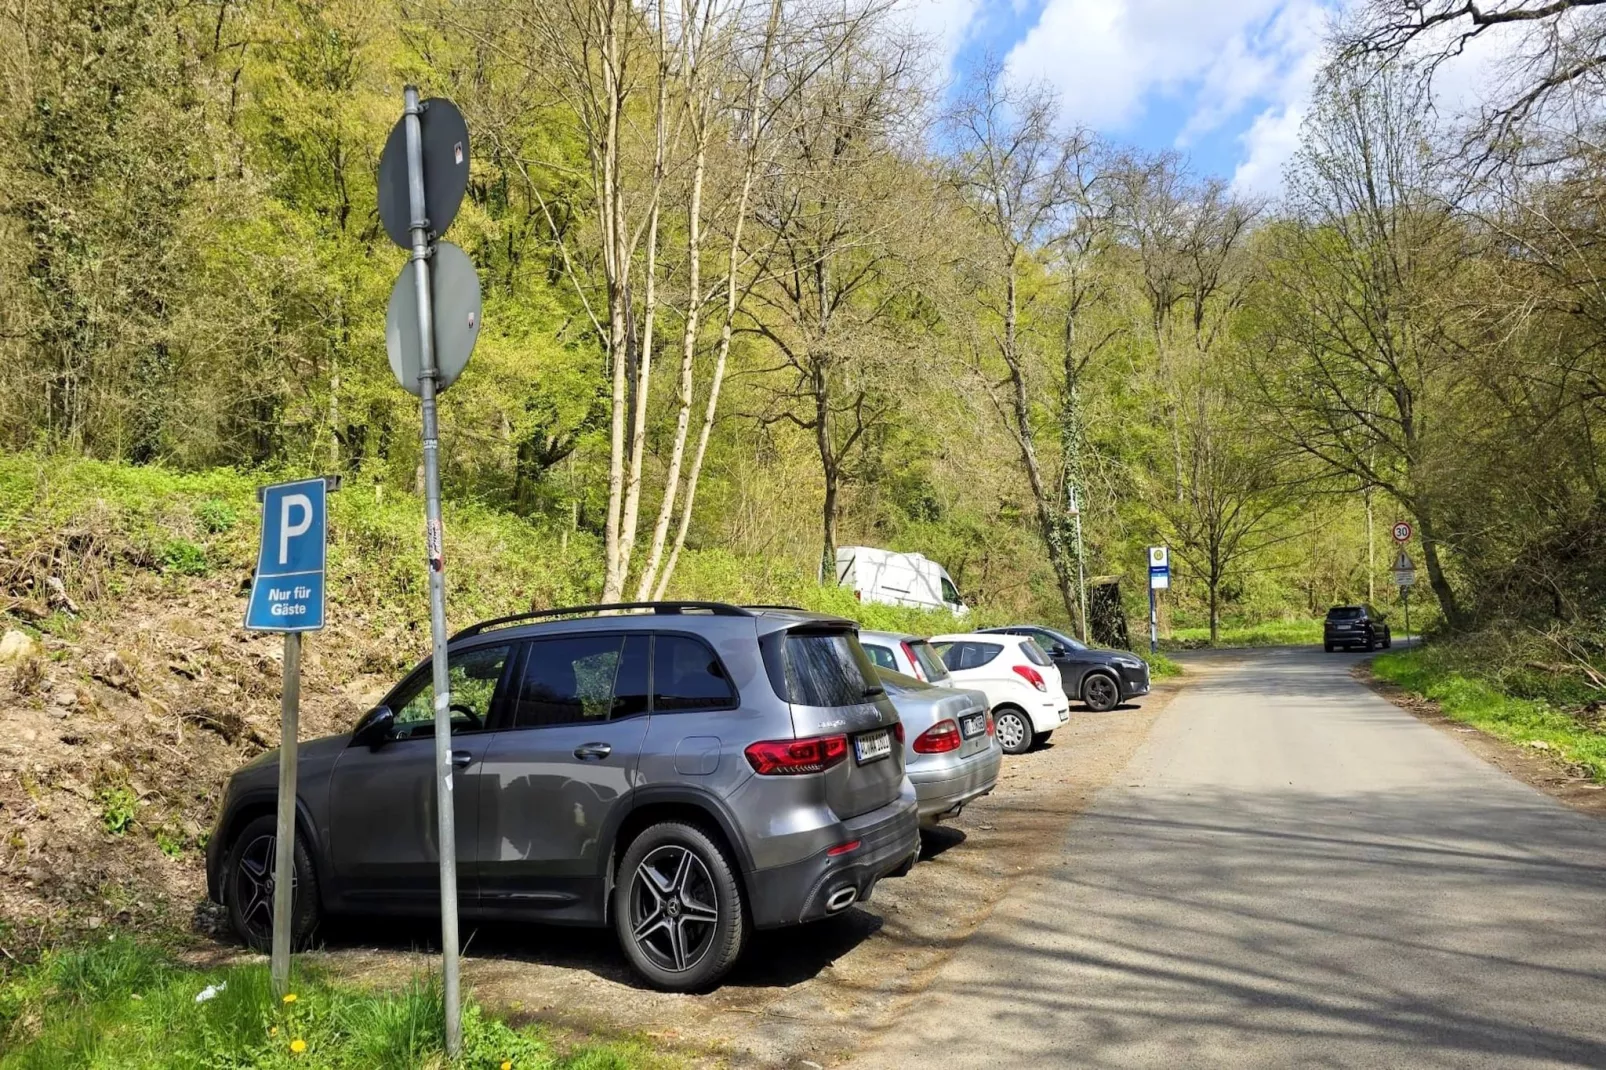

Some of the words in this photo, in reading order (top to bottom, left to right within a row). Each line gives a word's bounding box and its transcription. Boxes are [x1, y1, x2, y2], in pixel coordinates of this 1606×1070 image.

[279, 493, 313, 564] P
[1396, 527, 1408, 537] 30
[269, 588, 291, 601] Nur
[294, 586, 311, 600] für
[271, 603, 306, 615] Gäste
